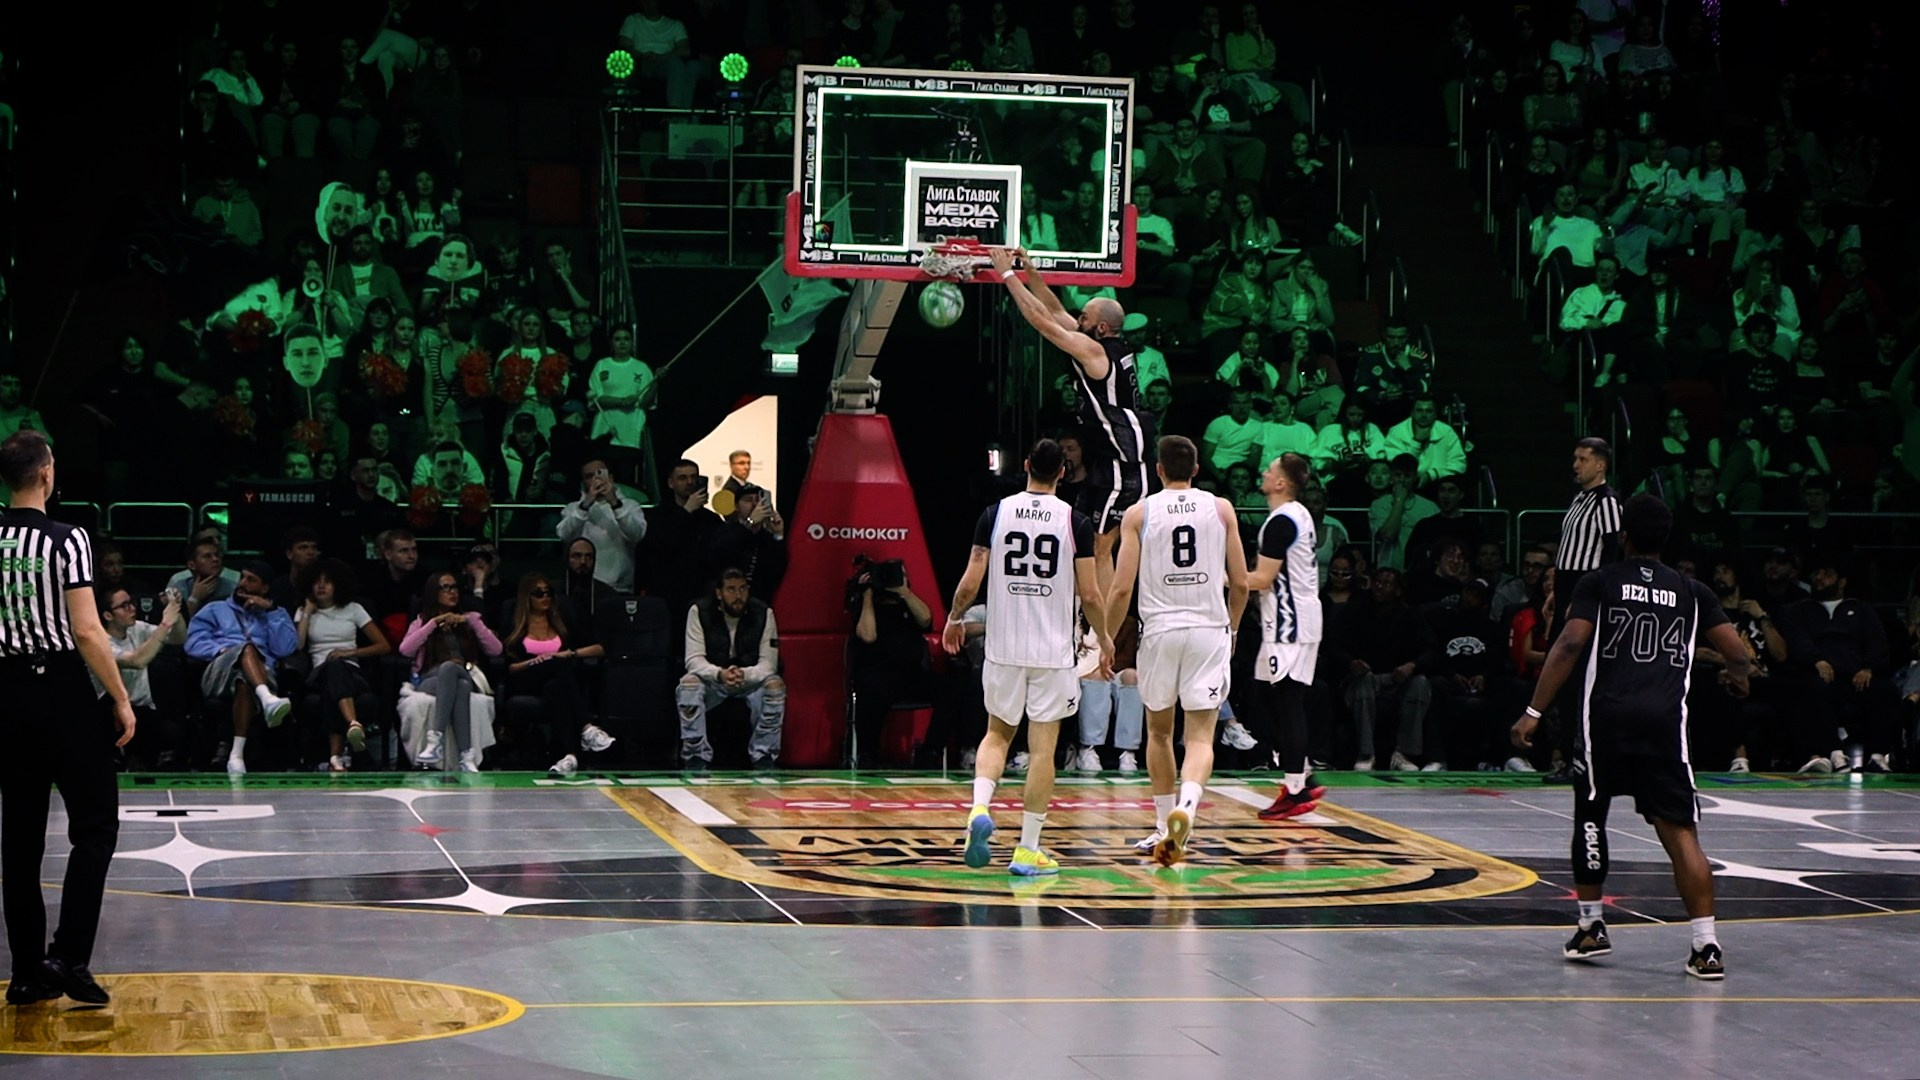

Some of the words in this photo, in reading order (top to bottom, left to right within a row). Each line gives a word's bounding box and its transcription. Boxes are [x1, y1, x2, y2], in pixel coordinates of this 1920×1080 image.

[924, 202, 999, 218] MEDIA
[924, 216, 999, 229] BASKET
[259, 492, 315, 503] YAMAGUCHI
[1015, 507, 1052, 523] MARKO
[1167, 502, 1197, 515] GATOS
[1004, 531, 1060, 578] 29
[1172, 525, 1197, 568] 8
[1651, 588, 1677, 608] GOD
[1602, 608, 1688, 667] 704
[1269, 655, 1279, 675] 9
[1583, 821, 1601, 870] deuce
